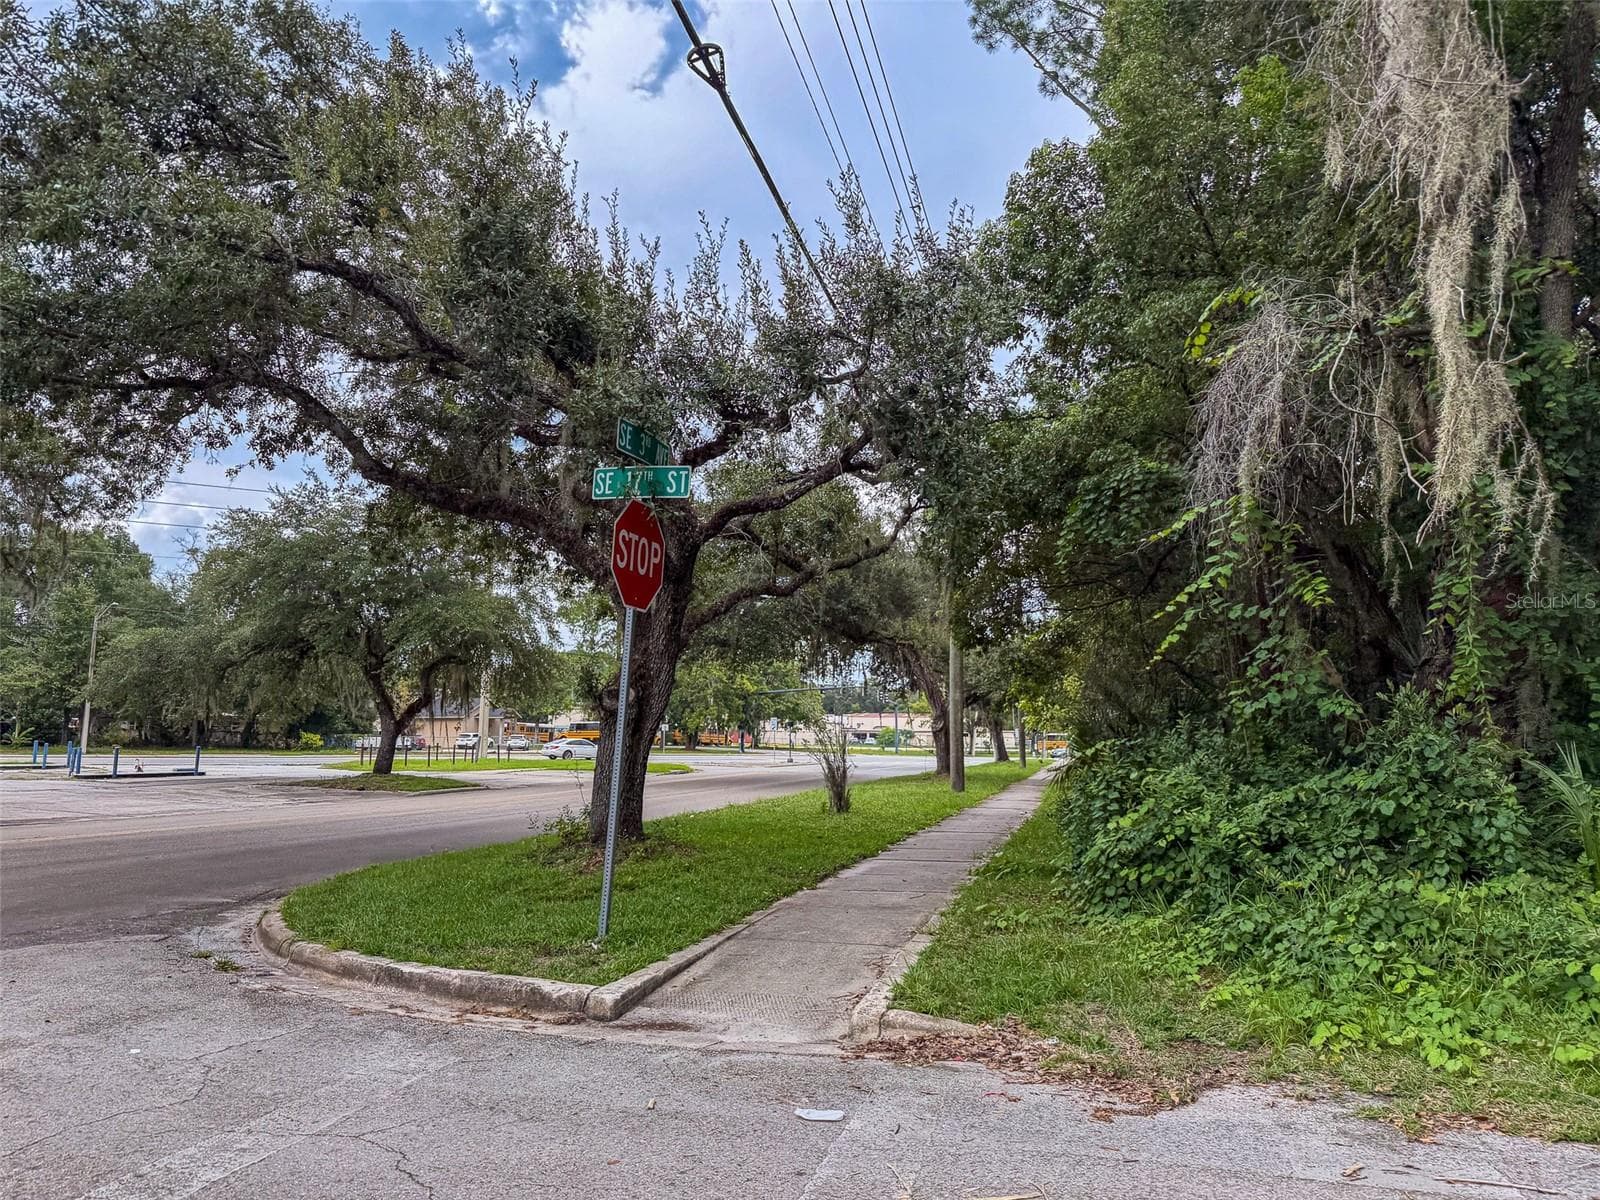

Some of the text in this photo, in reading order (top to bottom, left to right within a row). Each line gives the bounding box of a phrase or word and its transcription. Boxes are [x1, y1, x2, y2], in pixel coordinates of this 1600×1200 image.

[619, 423, 633, 449] SE
[596, 470, 688, 494] SE 17TH ST
[616, 528, 661, 578] STOP
